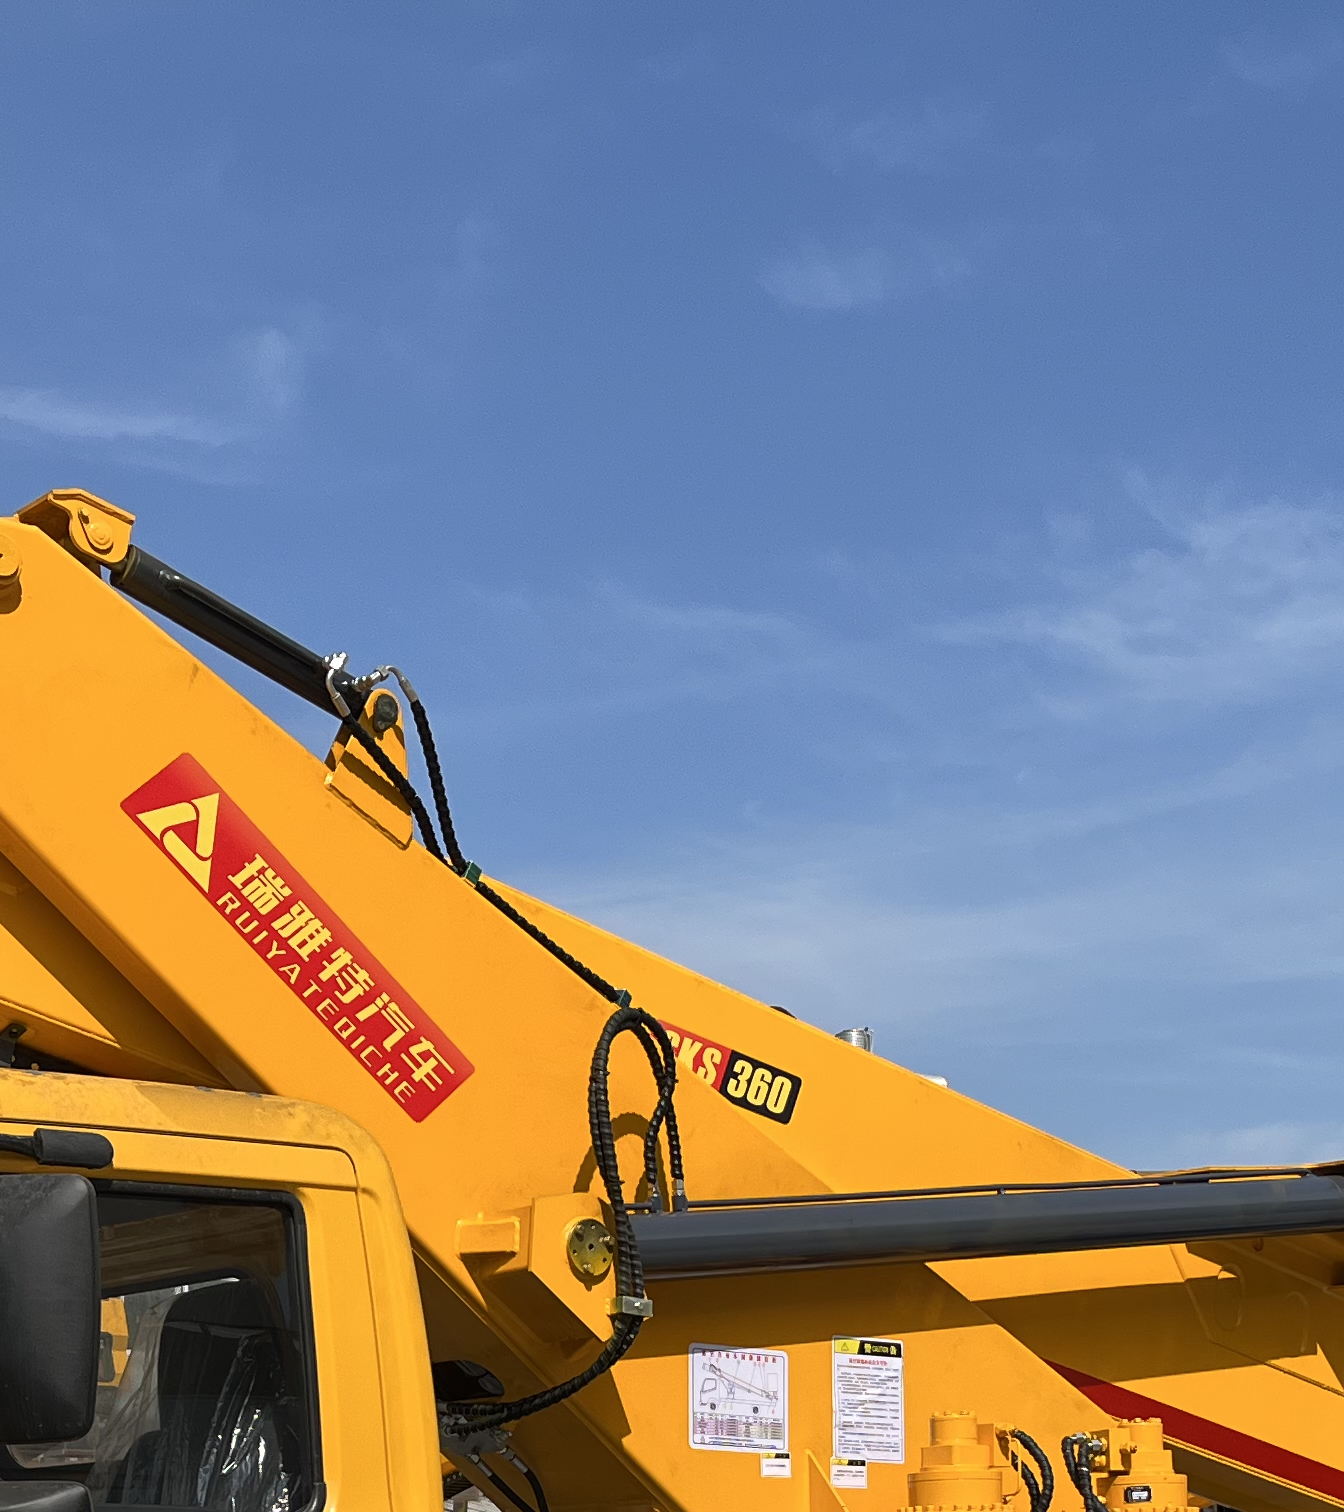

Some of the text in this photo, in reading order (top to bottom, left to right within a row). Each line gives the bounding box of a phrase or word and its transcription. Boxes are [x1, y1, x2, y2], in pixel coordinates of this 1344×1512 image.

[216, 891, 416, 1103] RUIYATEQICHE
[227, 853, 455, 1091] 瑞雅特汽车
[726, 1059, 792, 1115] 360
